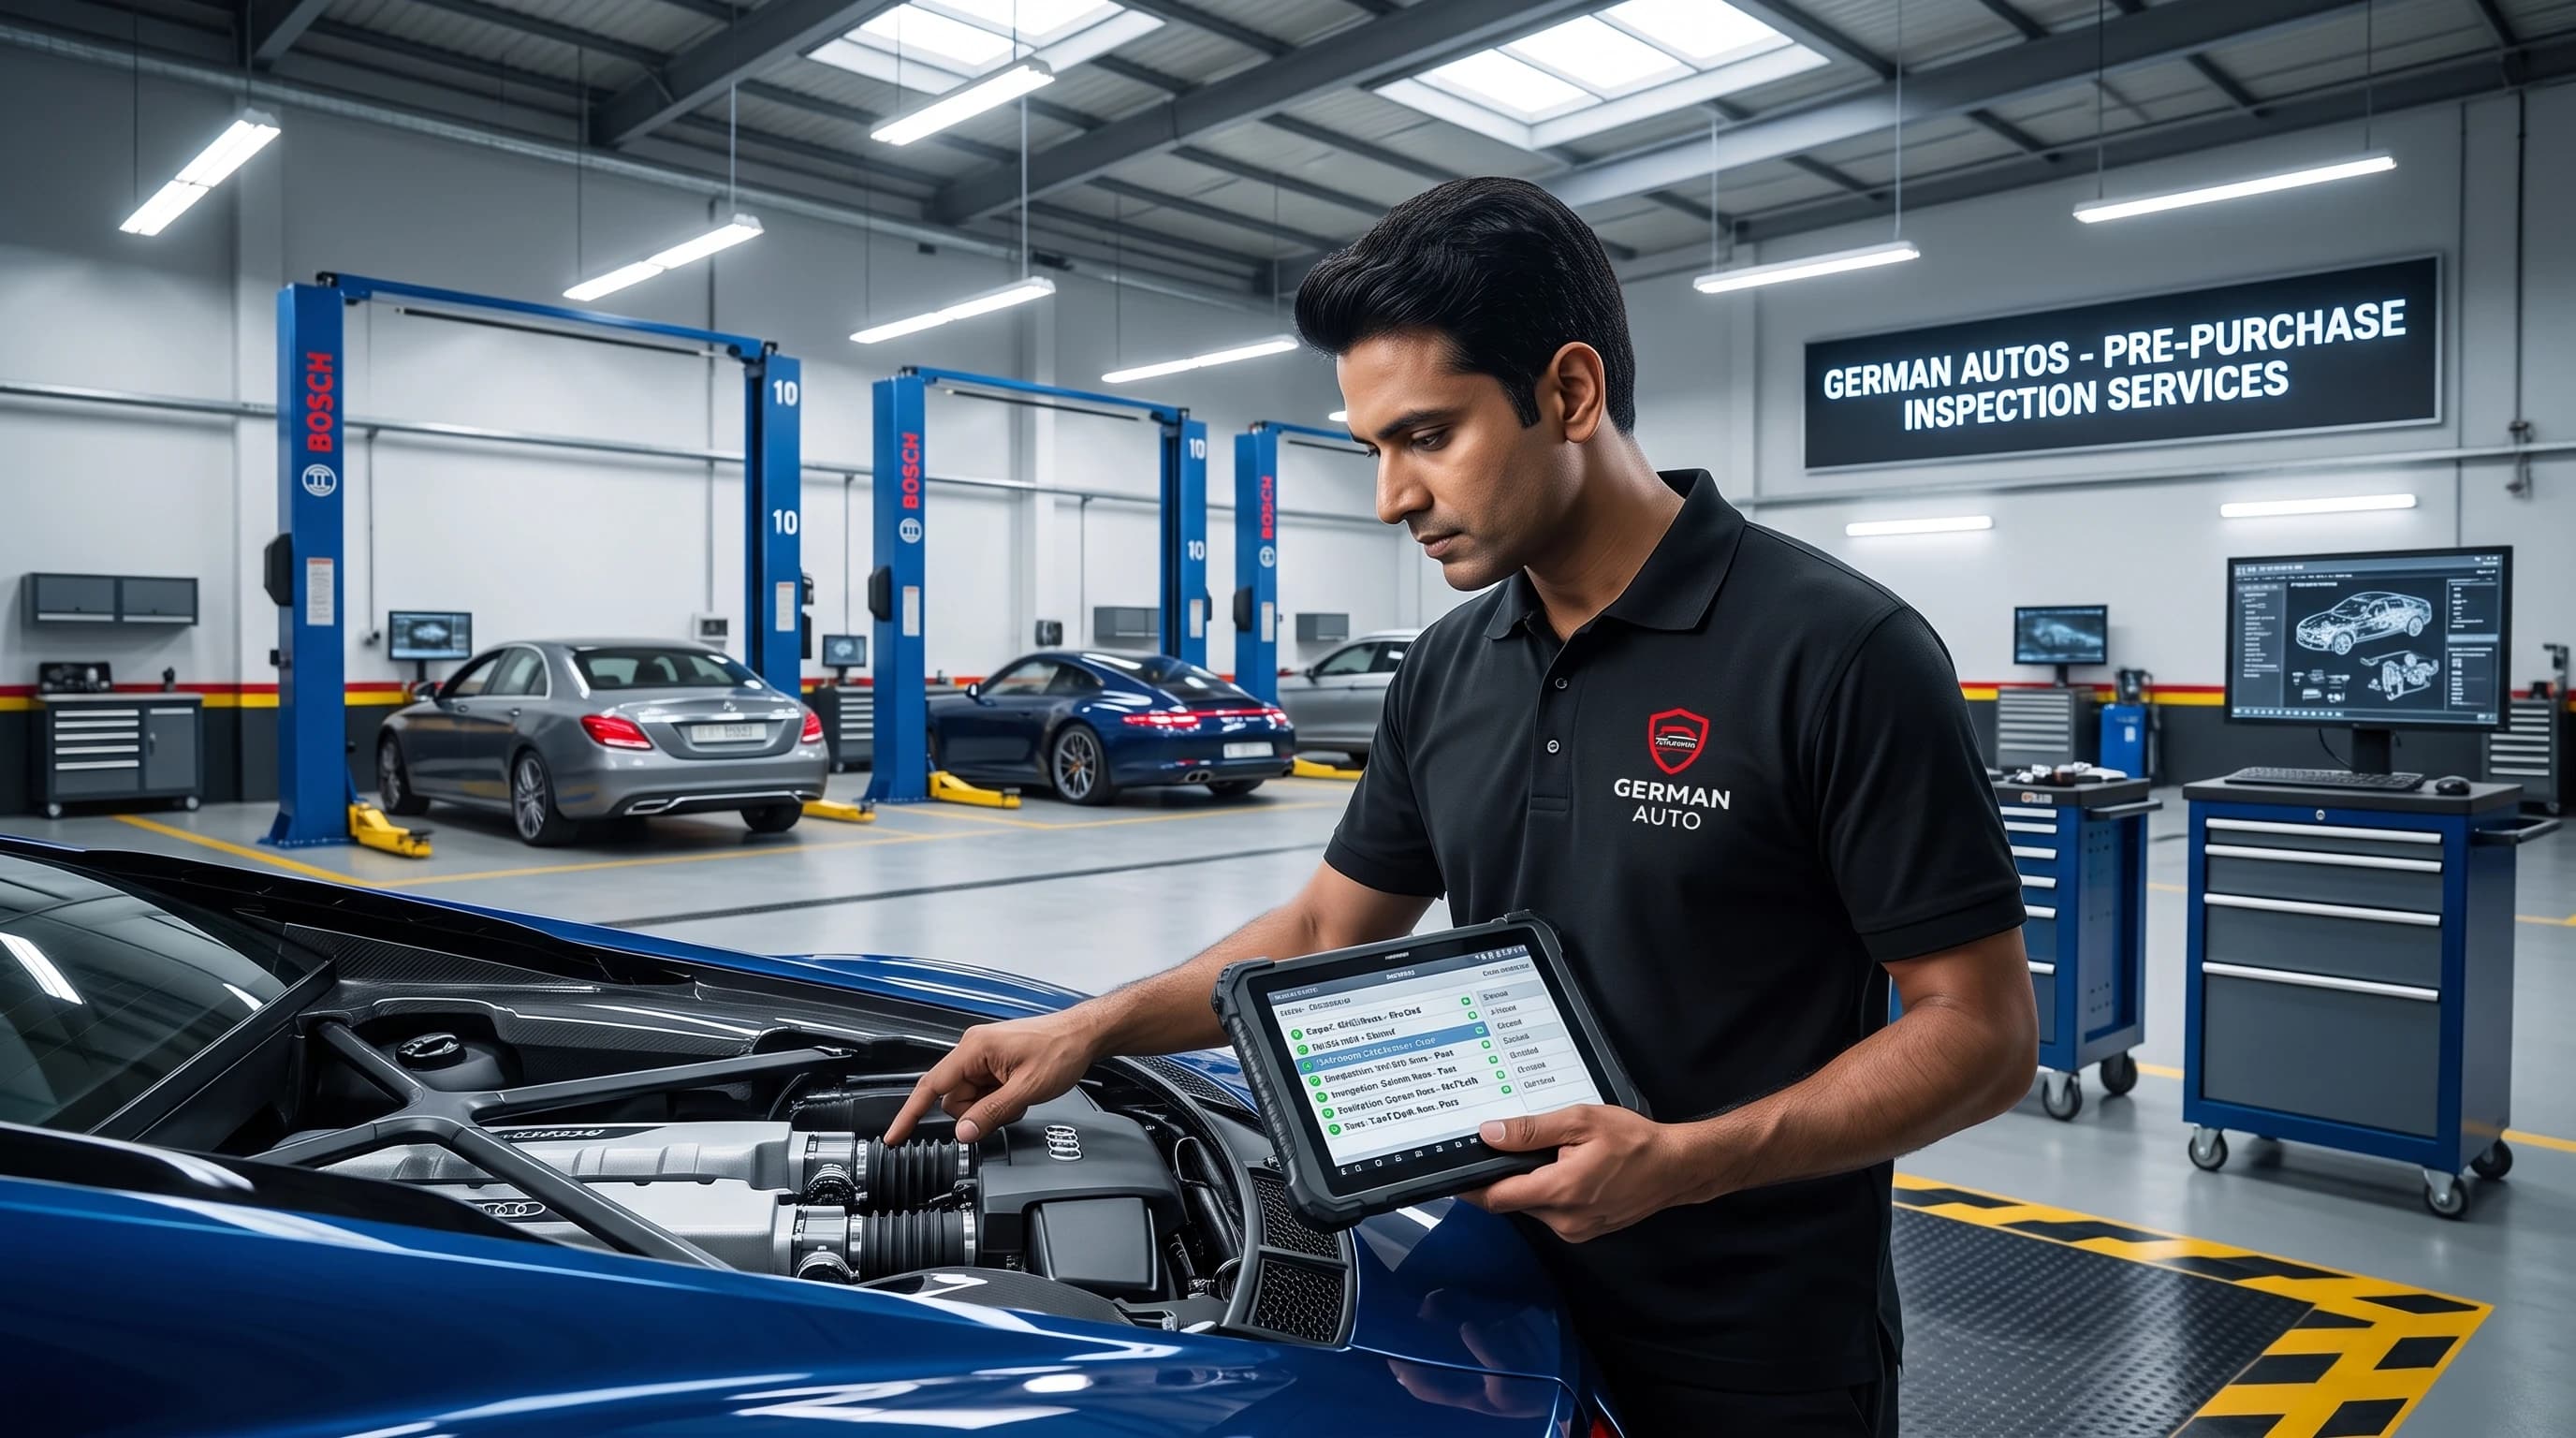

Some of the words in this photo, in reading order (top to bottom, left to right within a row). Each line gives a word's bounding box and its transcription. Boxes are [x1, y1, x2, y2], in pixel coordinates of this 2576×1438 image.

[1823, 355, 1952, 400] GERMAN
[1960, 341, 2070, 385] AUTOS
[2079, 353, 2094, 361] -
[2104, 299, 2407, 369] PRE-PURCHASE
[306, 353, 333, 452] BOSCH
[773, 380, 798, 405] 10
[1904, 380, 2097, 431] INSPECTION
[2107, 360, 2290, 411] SERVICES
[1190, 438, 1207, 459] 10
[901, 433, 920, 509] BOSCH
[773, 509, 798, 535] 10
[1188, 541, 1205, 560] 10
[1614, 778, 1731, 810] GERMAN
[1632, 804, 1702, 830] AUTO
